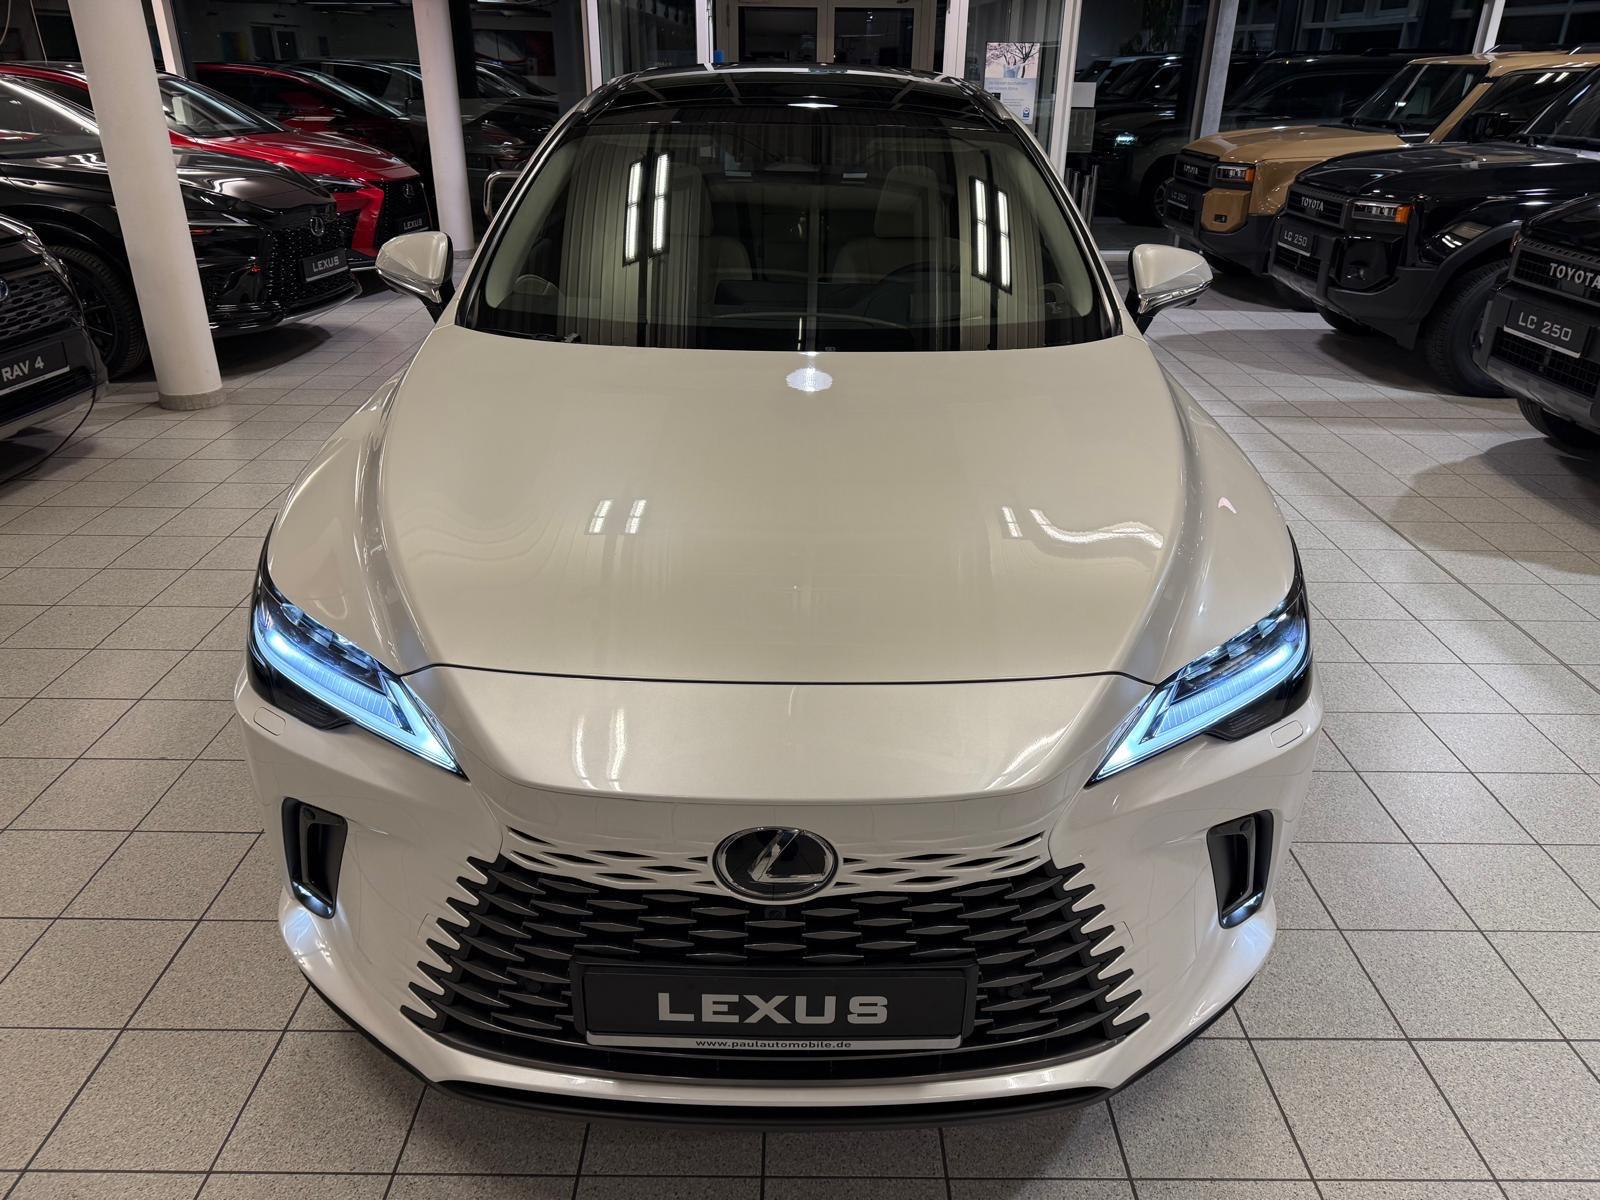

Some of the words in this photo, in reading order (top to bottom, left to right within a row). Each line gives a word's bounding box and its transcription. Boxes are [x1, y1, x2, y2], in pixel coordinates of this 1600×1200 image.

[1301, 196, 1324, 212] TOYOTA
[403, 218, 424, 230] LEXUS
[1284, 230, 1293, 241] LC
[1294, 234, 1308, 247] 250
[312, 255, 340, 272] LEXUS
[1549, 262, 1600, 289] TOYOTA
[1518, 311, 1537, 329] LC
[1541, 321, 1572, 341] 250
[1, 360, 29, 382] RAV
[34, 355, 45, 369] 4
[657, 992, 889, 1025] LEXUS
[695, 1038, 852, 1050] www.paulautomobile.de
